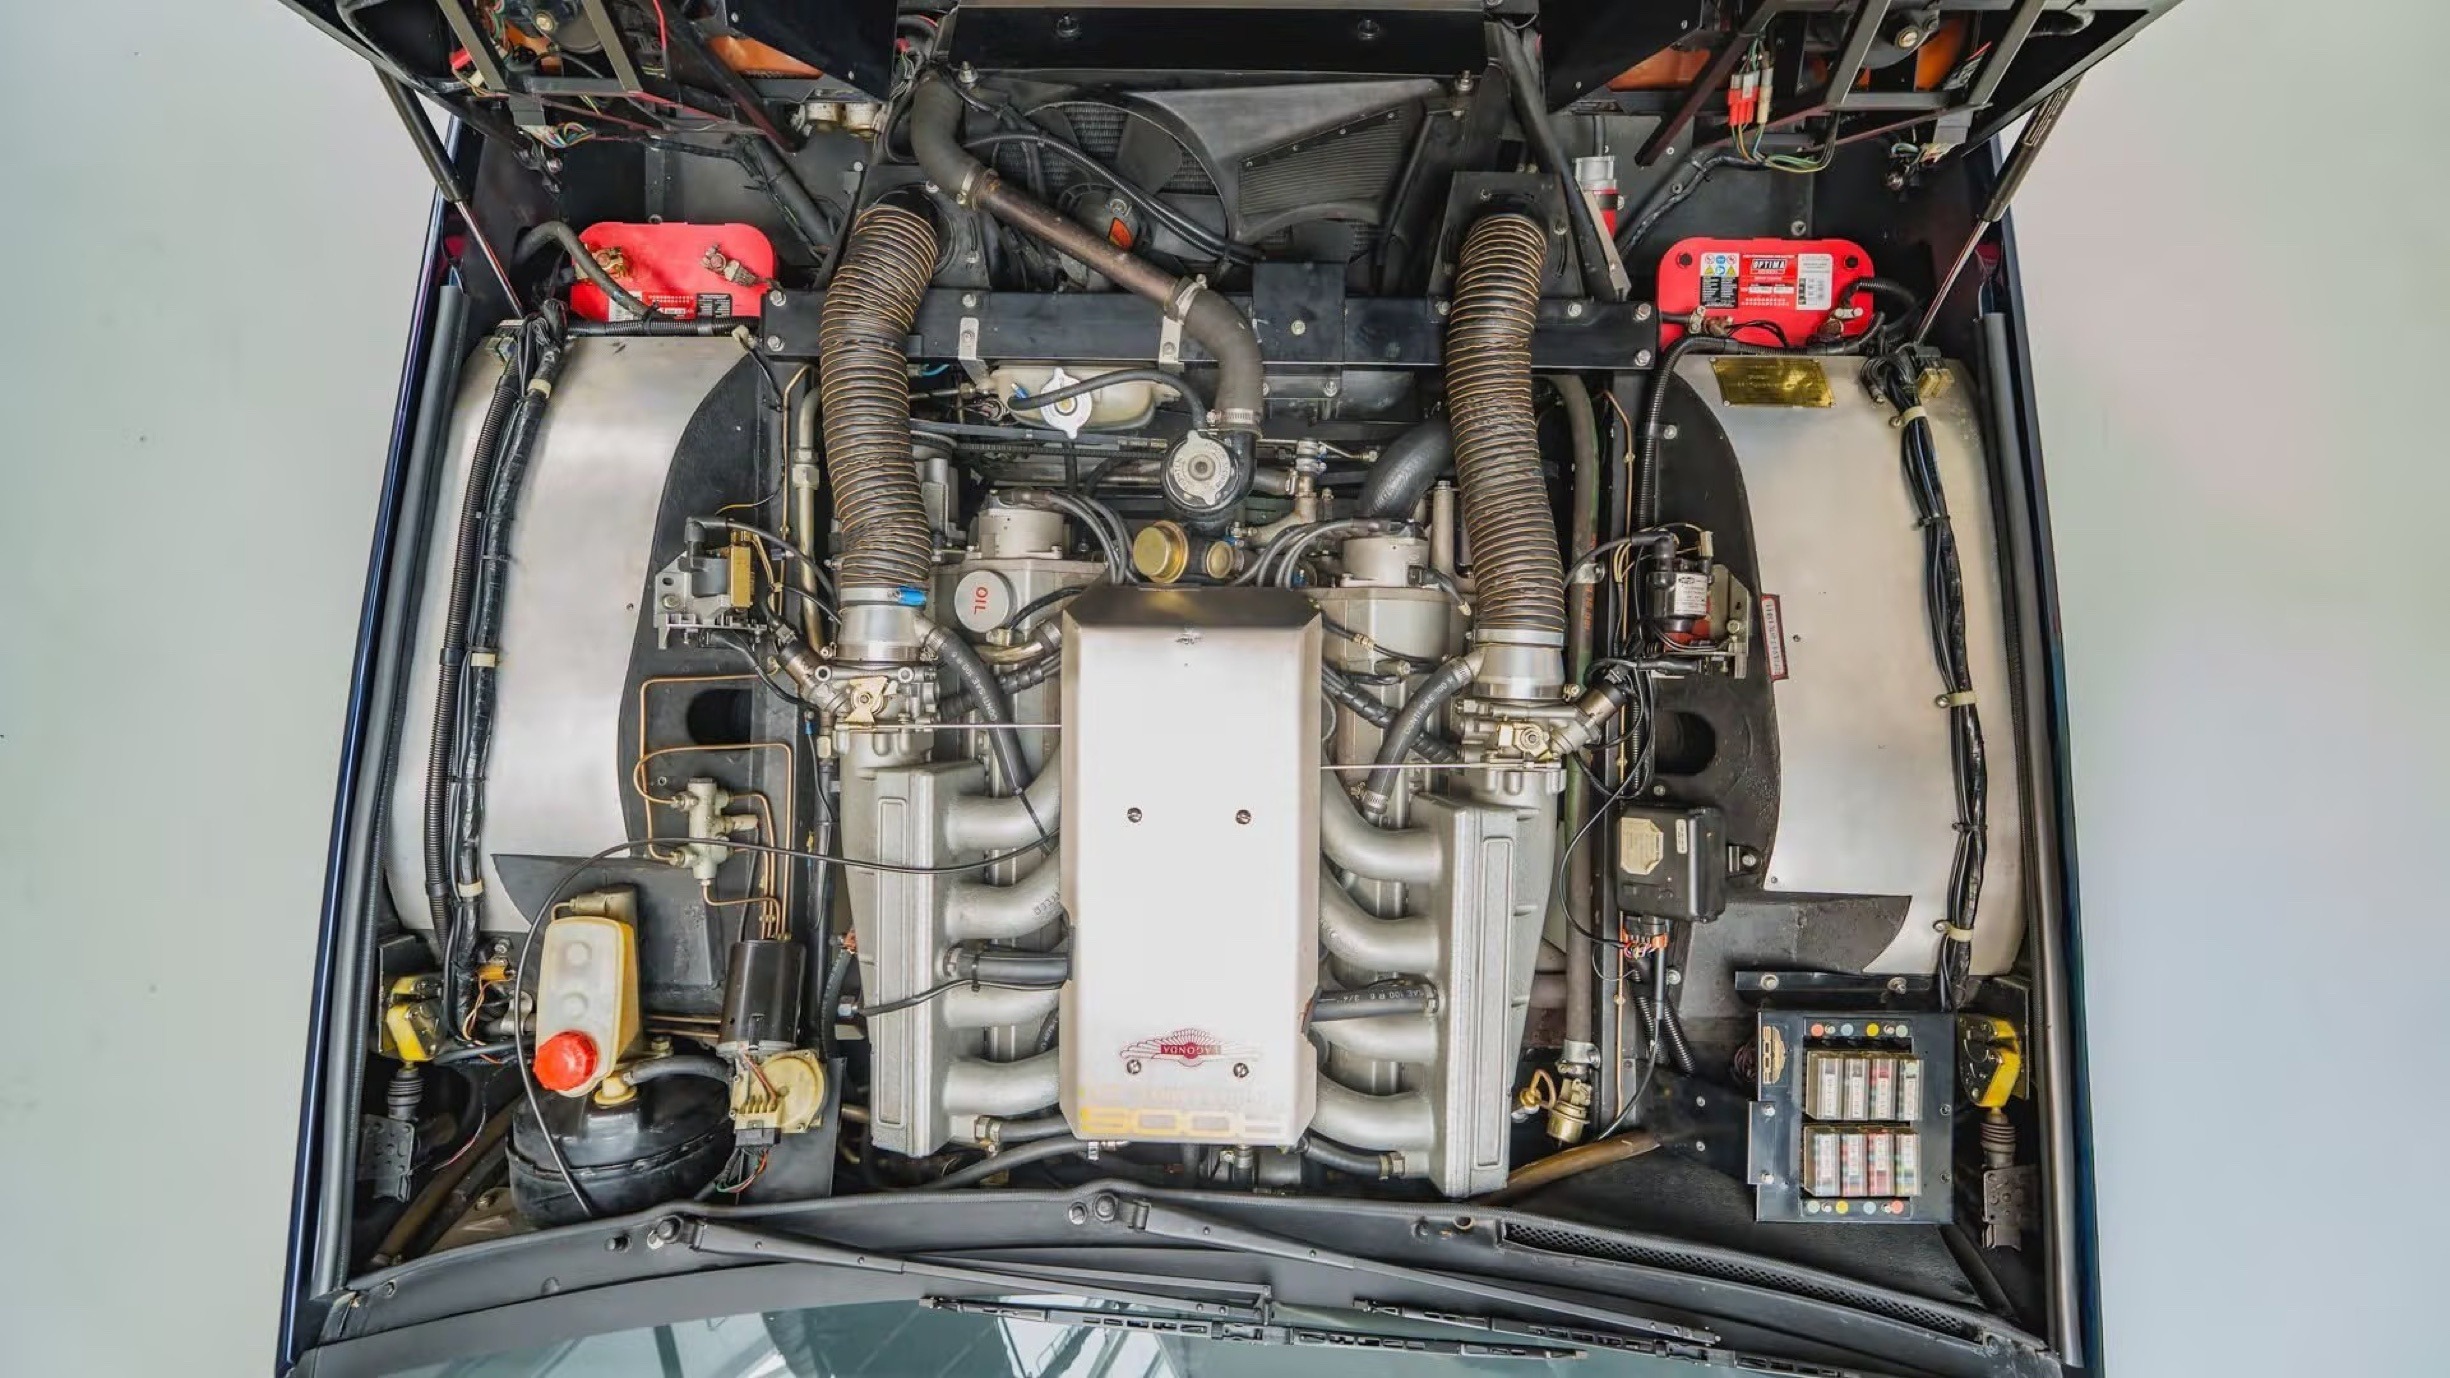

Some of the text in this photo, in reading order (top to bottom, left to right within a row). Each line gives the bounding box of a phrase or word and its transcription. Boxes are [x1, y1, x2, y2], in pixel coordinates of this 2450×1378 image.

[1752, 259, 1786, 269] OPTIMA
[973, 586, 989, 615] OIL
[1163, 1044, 1220, 1056] LAGONDA
